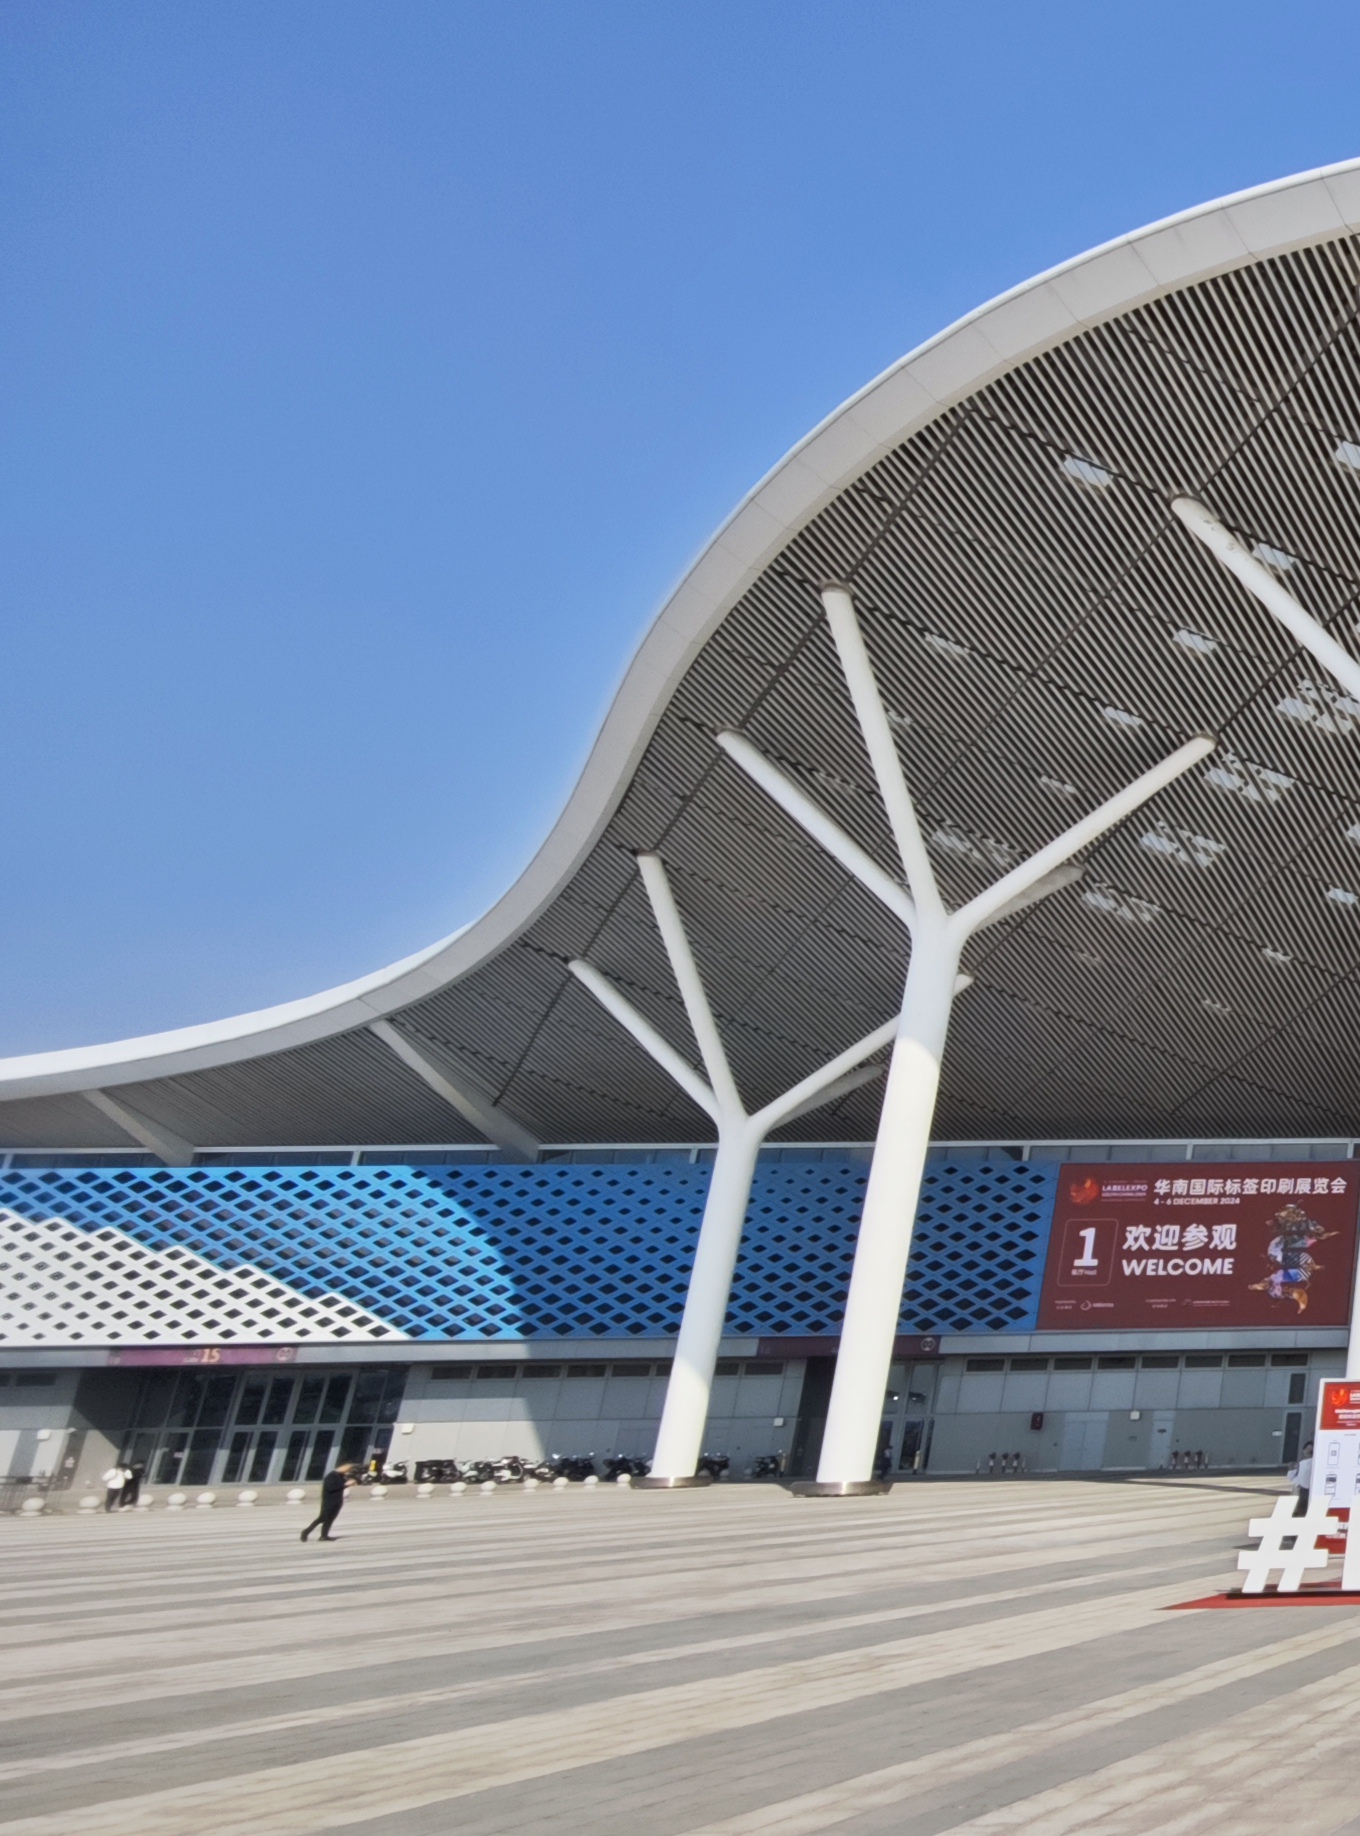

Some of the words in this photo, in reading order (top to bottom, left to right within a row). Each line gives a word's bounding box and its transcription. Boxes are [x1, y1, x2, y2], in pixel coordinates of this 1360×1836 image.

[1102, 1184, 1149, 1192] LABELEXPO
[1153, 1177, 1347, 1196] 华南国际标签印刷展览会
[1173, 1198, 1219, 1206] DECEMBER
[1220, 1197, 1241, 1205] 2024
[1122, 1223, 1237, 1251] 欢迎参观
[1073, 1227, 1099, 1267] 1
[1121, 1258, 1235, 1276] WELCOME
[201, 1348, 221, 1363] 15
